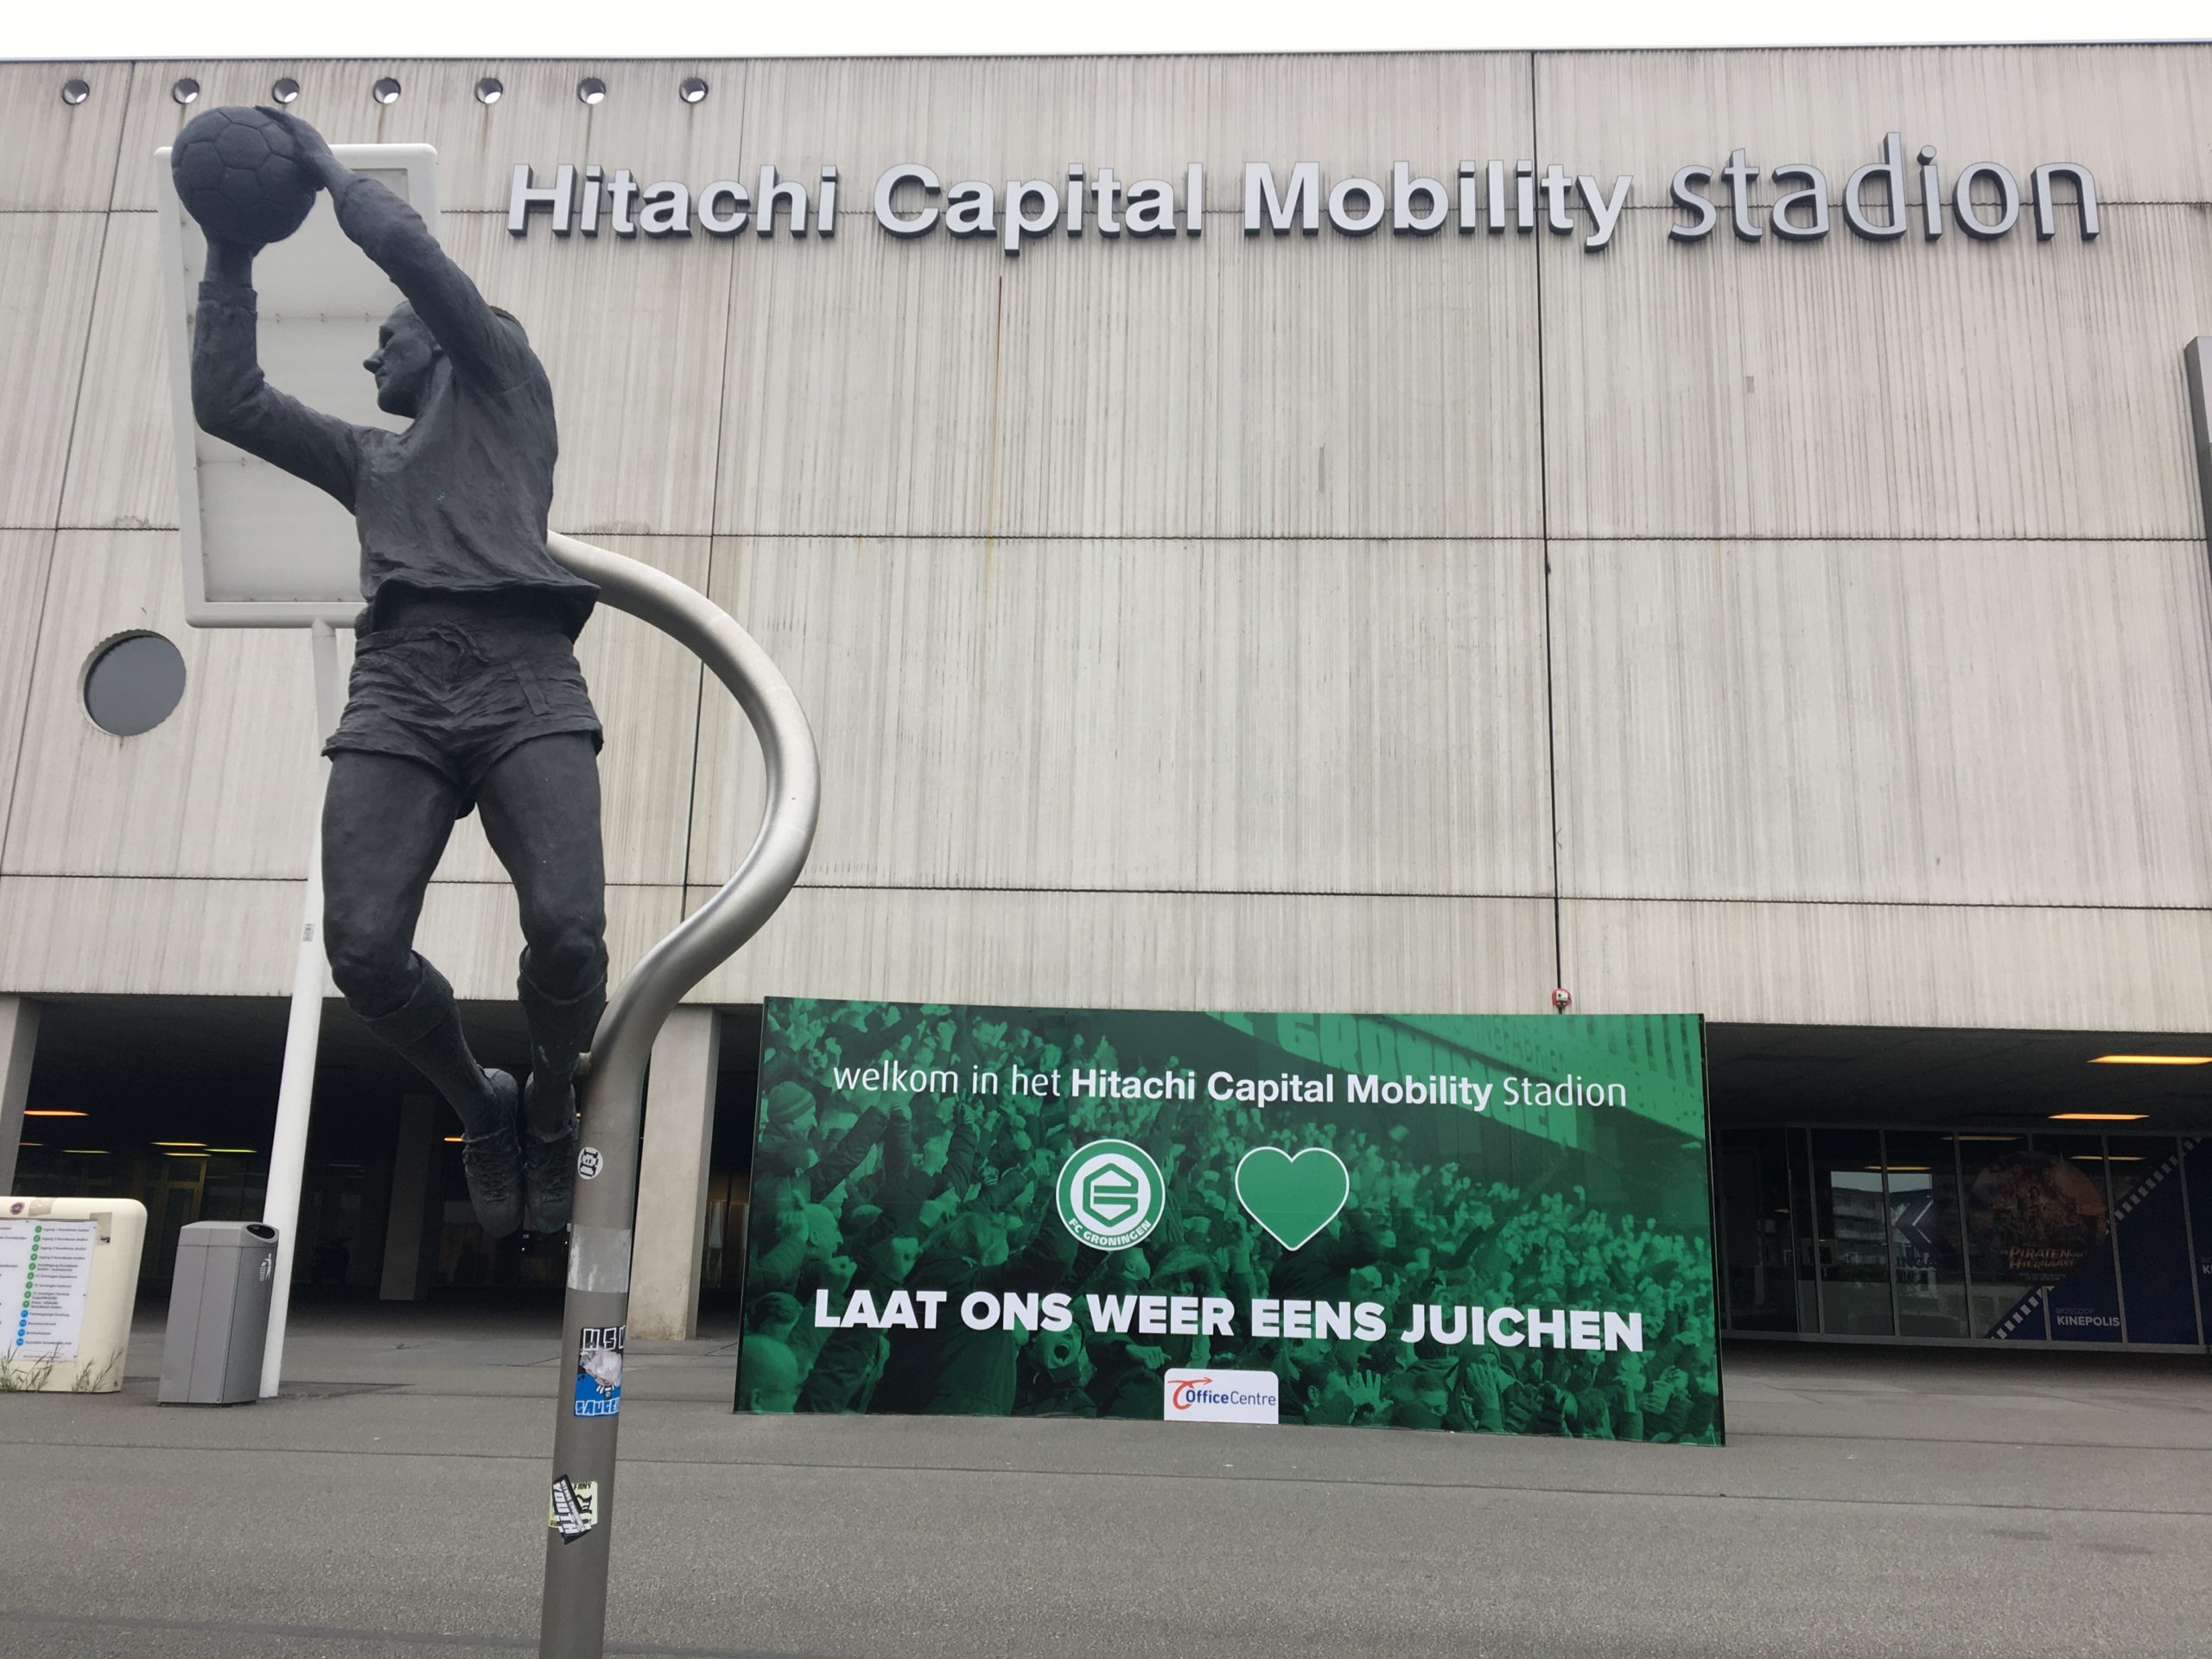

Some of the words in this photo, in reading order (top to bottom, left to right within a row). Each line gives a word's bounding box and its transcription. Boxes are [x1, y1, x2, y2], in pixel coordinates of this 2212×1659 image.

[507, 163, 838, 238] Hitachi
[874, 162, 1203, 256] Capital
[1243, 159, 1634, 252] Mobility
[1669, 131, 2100, 242] stadion
[833, 1060, 958, 1094] welkom
[972, 1064, 999, 1095] in
[1011, 1064, 1061, 1096] het
[1071, 1068, 1195, 1100] Hitachi
[1207, 1071, 1333, 1107] Capital
[1347, 1073, 1492, 1111] Mobility
[1503, 1073, 1626, 1107] Stadion
[1068, 1217, 1083, 1234] FC
[1083, 1219, 1152, 1246] GRONINGEN
[814, 1288, 947, 1330] LAAT
[960, 1291, 1073, 1332] ONS
[1086, 1294, 1235, 1337] WEER
[1251, 1299, 1387, 1342] EENS
[1401, 1303, 1643, 1352] JUICHEN
[2056, 1315, 2120, 1327] KINEPOLIS
[552, 1481, 580, 1535] YOUTH
